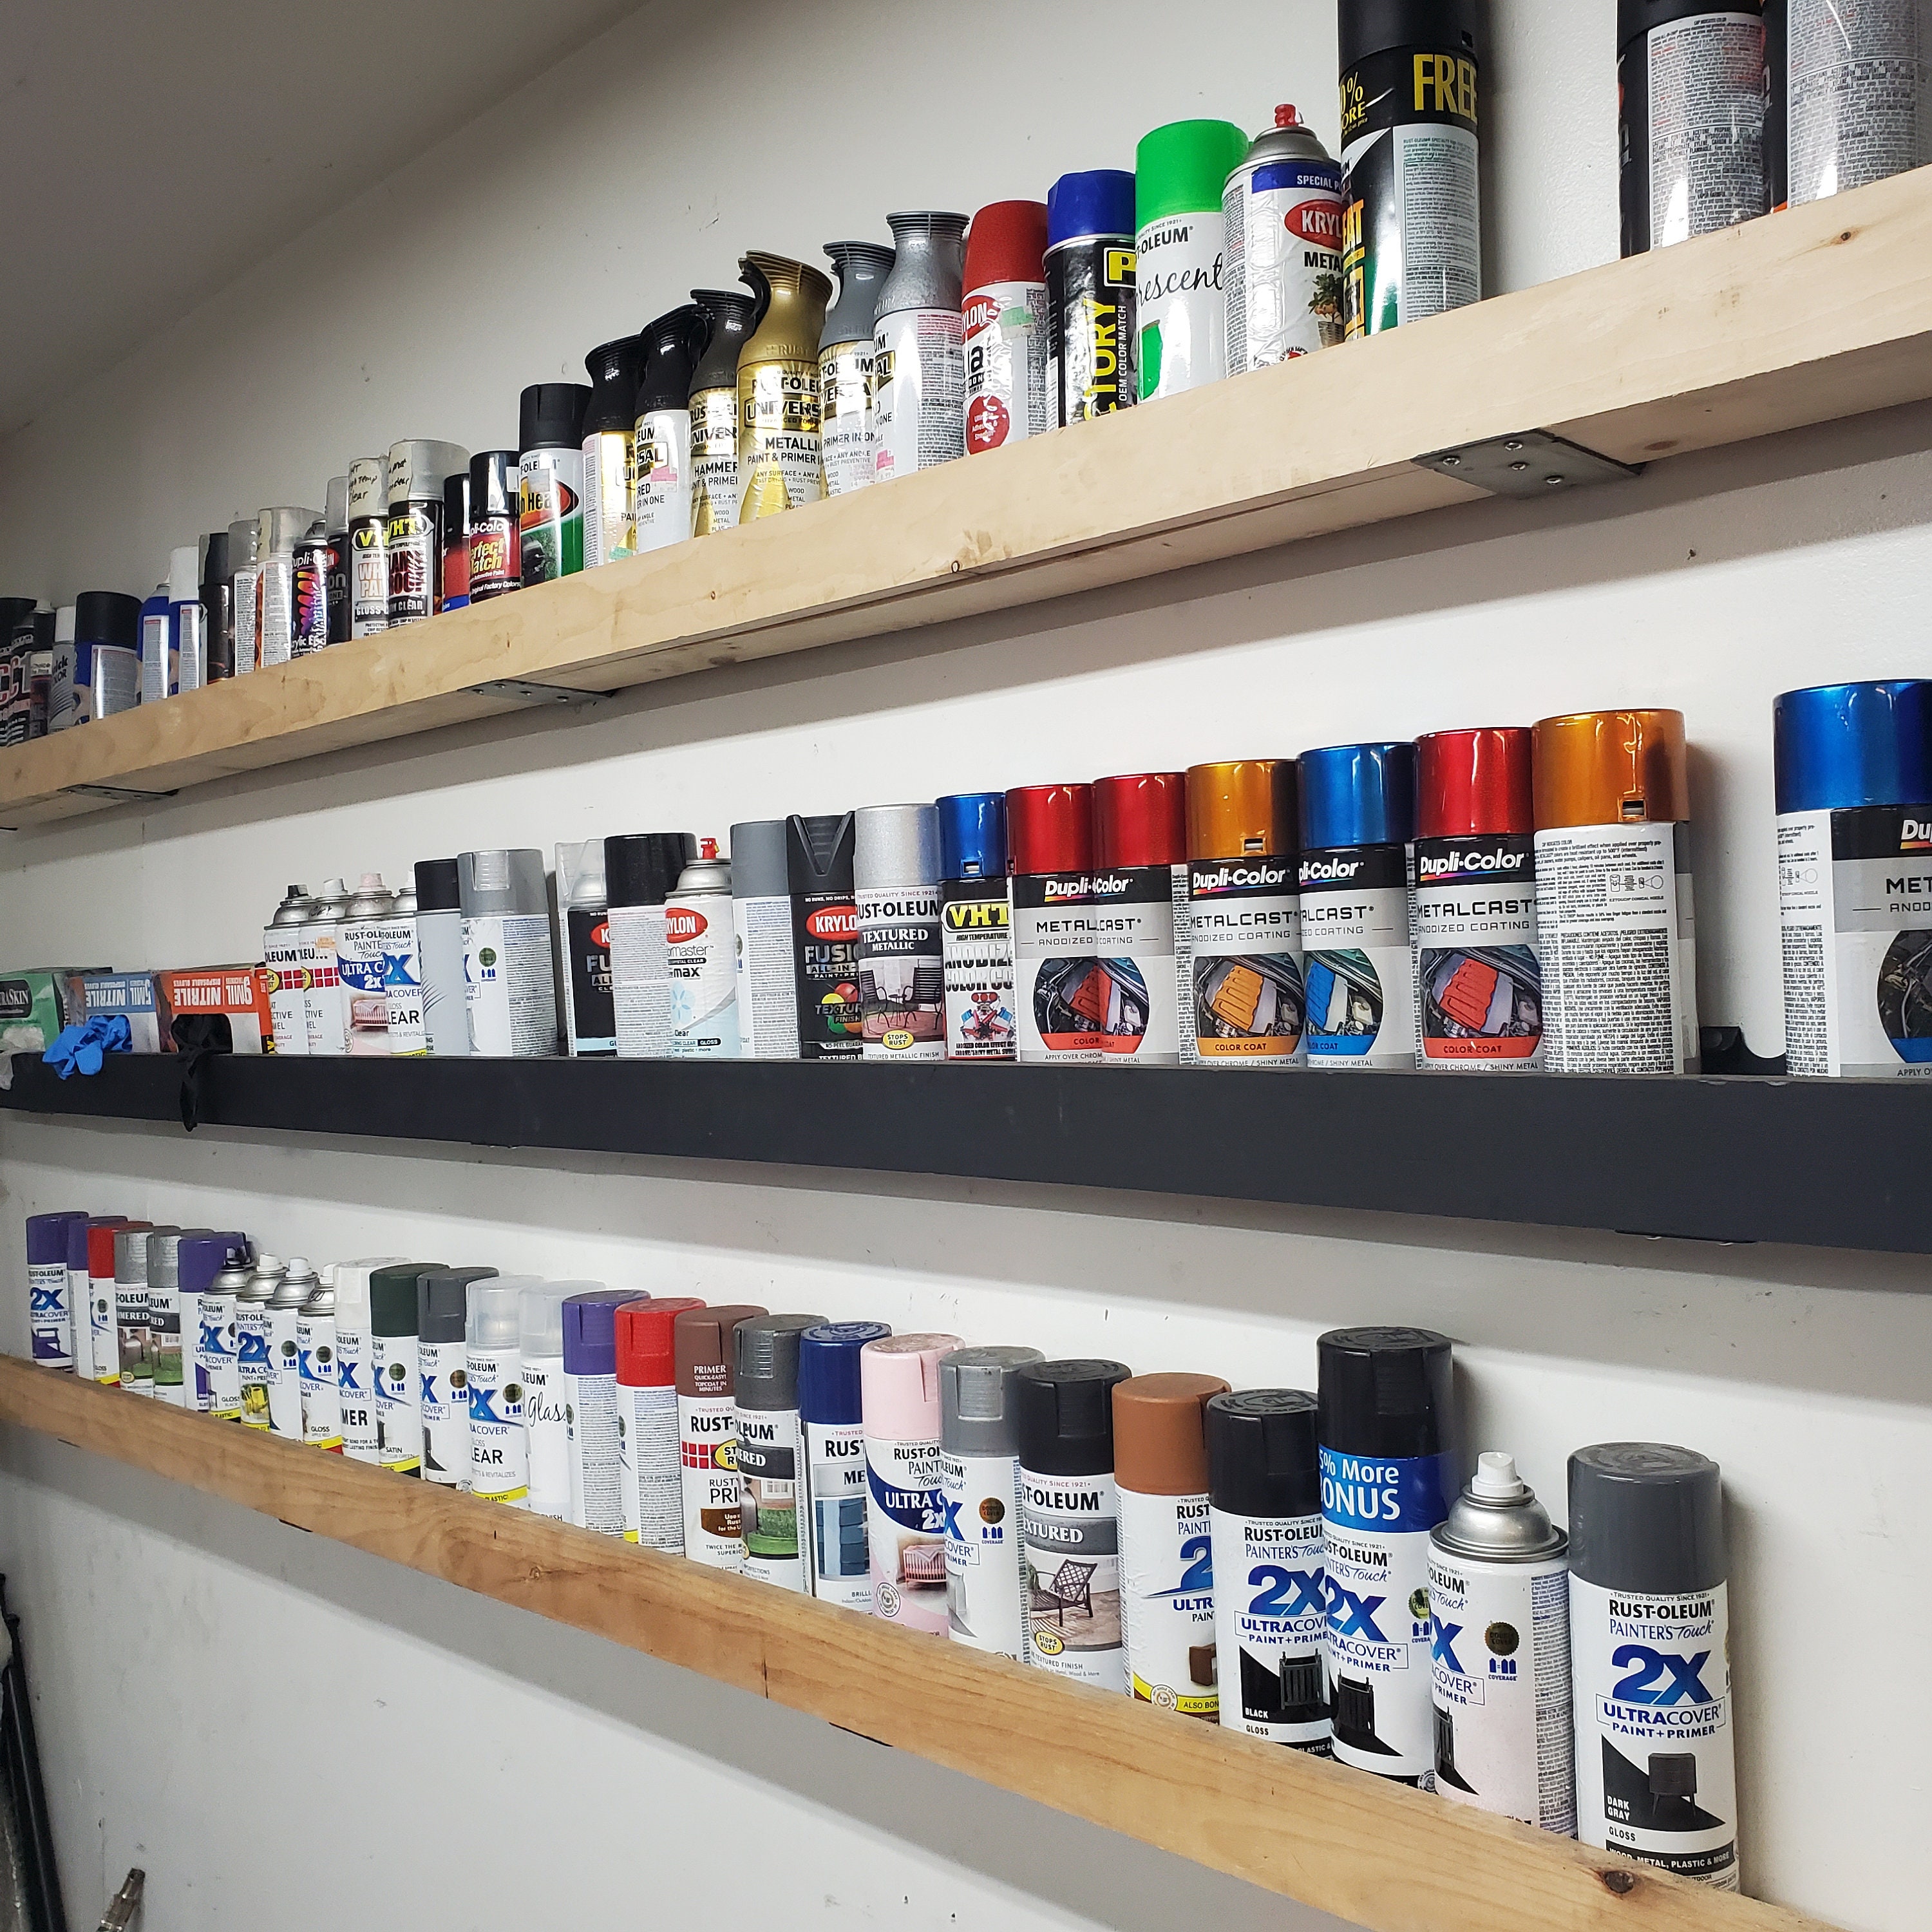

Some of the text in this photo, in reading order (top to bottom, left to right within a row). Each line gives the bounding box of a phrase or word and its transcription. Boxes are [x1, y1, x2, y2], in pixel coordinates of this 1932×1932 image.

[1414, 54, 1478, 126] FREE
[1297, 175, 1332, 189] SPECIAL
[1304, 252, 1343, 274] META
[1118, 305, 1128, 402] OEM COLOR MATCH
[824, 433, 849, 450] PRIMER
[748, 452, 816, 465] PAINT & PRIMER
[650, 495, 665, 506] ONE
[356, 605, 381, 616] GLOSS
[949, 904, 1010, 927] VHT
[1315, 926, 1363, 936] COATING
[1470, 921, 1530, 932] COATING
[862, 928, 929, 944] TEXTURED
[969, 932, 1009, 941] TEMPERATURE
[1039, 936, 1093, 946] ANODIZED
[1238, 931, 1291, 940] COATING
[872, 941, 914, 952] METALLIC
[342, 961, 372, 977] ULTRA
[192, 978, 221, 987] DISPOSABLE
[86, 989, 126, 1008] NITRILE
[174, 987, 222, 1007] NITRILE
[835, 1015, 860, 1023] FINISH
[1074, 1037, 1100, 1045] COLOR
[1244, 1043, 1267, 1051] COAT
[890, 1051, 918, 1060] METALLIC
[1443, 1045, 1502, 1054] COLOR COAT
[1897, 1068, 1921, 1077] APPLY
[30, 1287, 65, 1311] 2X
[694, 1365, 726, 1374] PRIMER
[1342, 1458, 1399, 1484] More
[1027, 1476, 1047, 1486] QUALITY
[885, 1491, 933, 1509] ULTRA
[1332, 1535, 1350, 1545] QUALITY
[1436, 1563, 1448, 1572] SINCE
[1247, 1564, 1326, 1617] 2X
[1613, 1591, 1644, 1601] TRUSTED
[1325, 1574, 1390, 1643] 2X
[1609, 1618, 1673, 1641] PAINTER'S
[1039, 1636, 1057, 1646] STOPS
[1040, 1641, 1057, 1651] RUST
[1034, 1654, 1083, 1670] TEXTURED FINISH
[1611, 1643, 1714, 1707] 2X
[1434, 1683, 1468, 1705] PRIMER
[1184, 1701, 1203, 1709] ALSO
[1245, 1707, 1269, 1719] BLACK
[1246, 1725, 1269, 1736] GLOSS
[1607, 1795, 1630, 1811] DARK
[1607, 1806, 1630, 1821] GRAY
[1609, 1826, 1636, 1842] GLOSS
[1637, 1856, 1670, 1870] METAL,
[1671, 1859, 1706, 1869] PLASTIC
[1714, 1852, 1730, 1865] MORE
